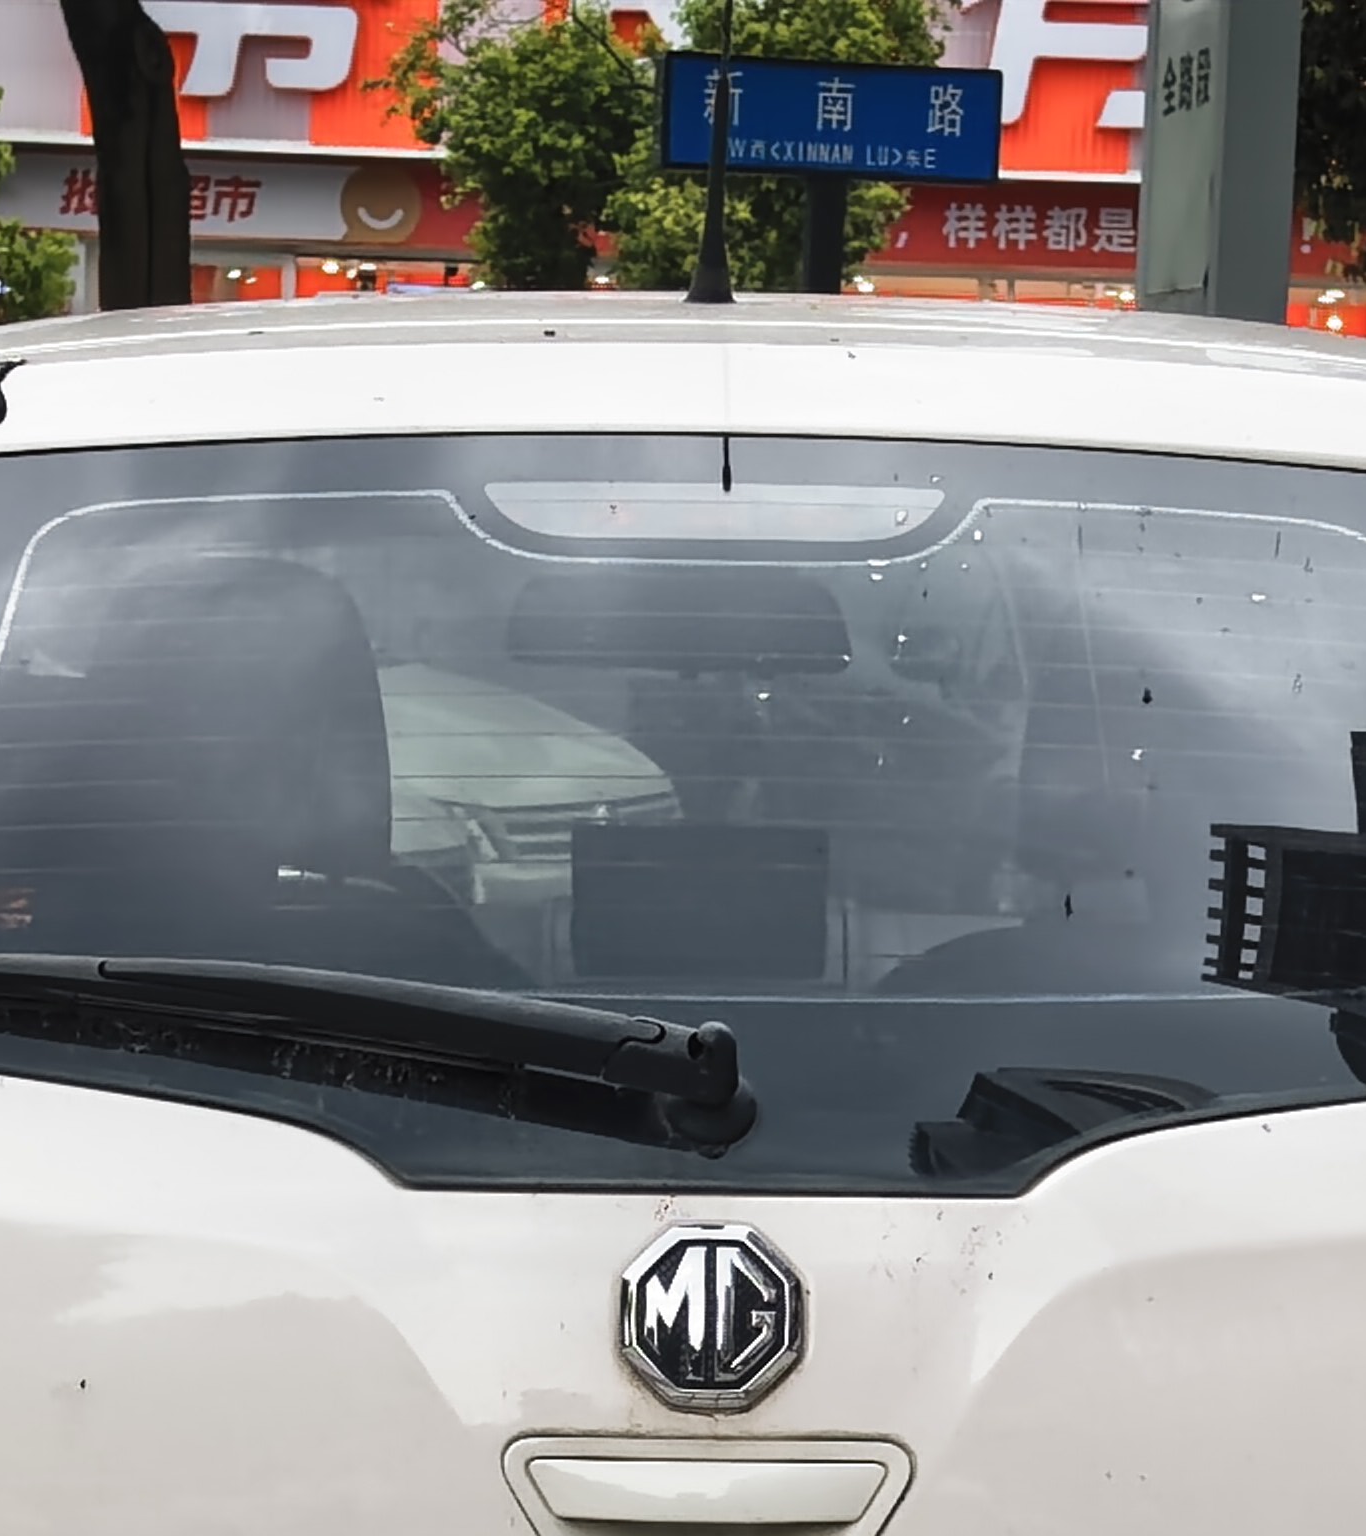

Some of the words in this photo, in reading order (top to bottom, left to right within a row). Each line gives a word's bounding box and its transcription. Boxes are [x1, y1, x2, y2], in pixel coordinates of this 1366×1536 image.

[703, 68, 964, 137] 新南路
[1162, 47, 1212, 117] 全路段
[641, 1245, 780, 1383] MG
